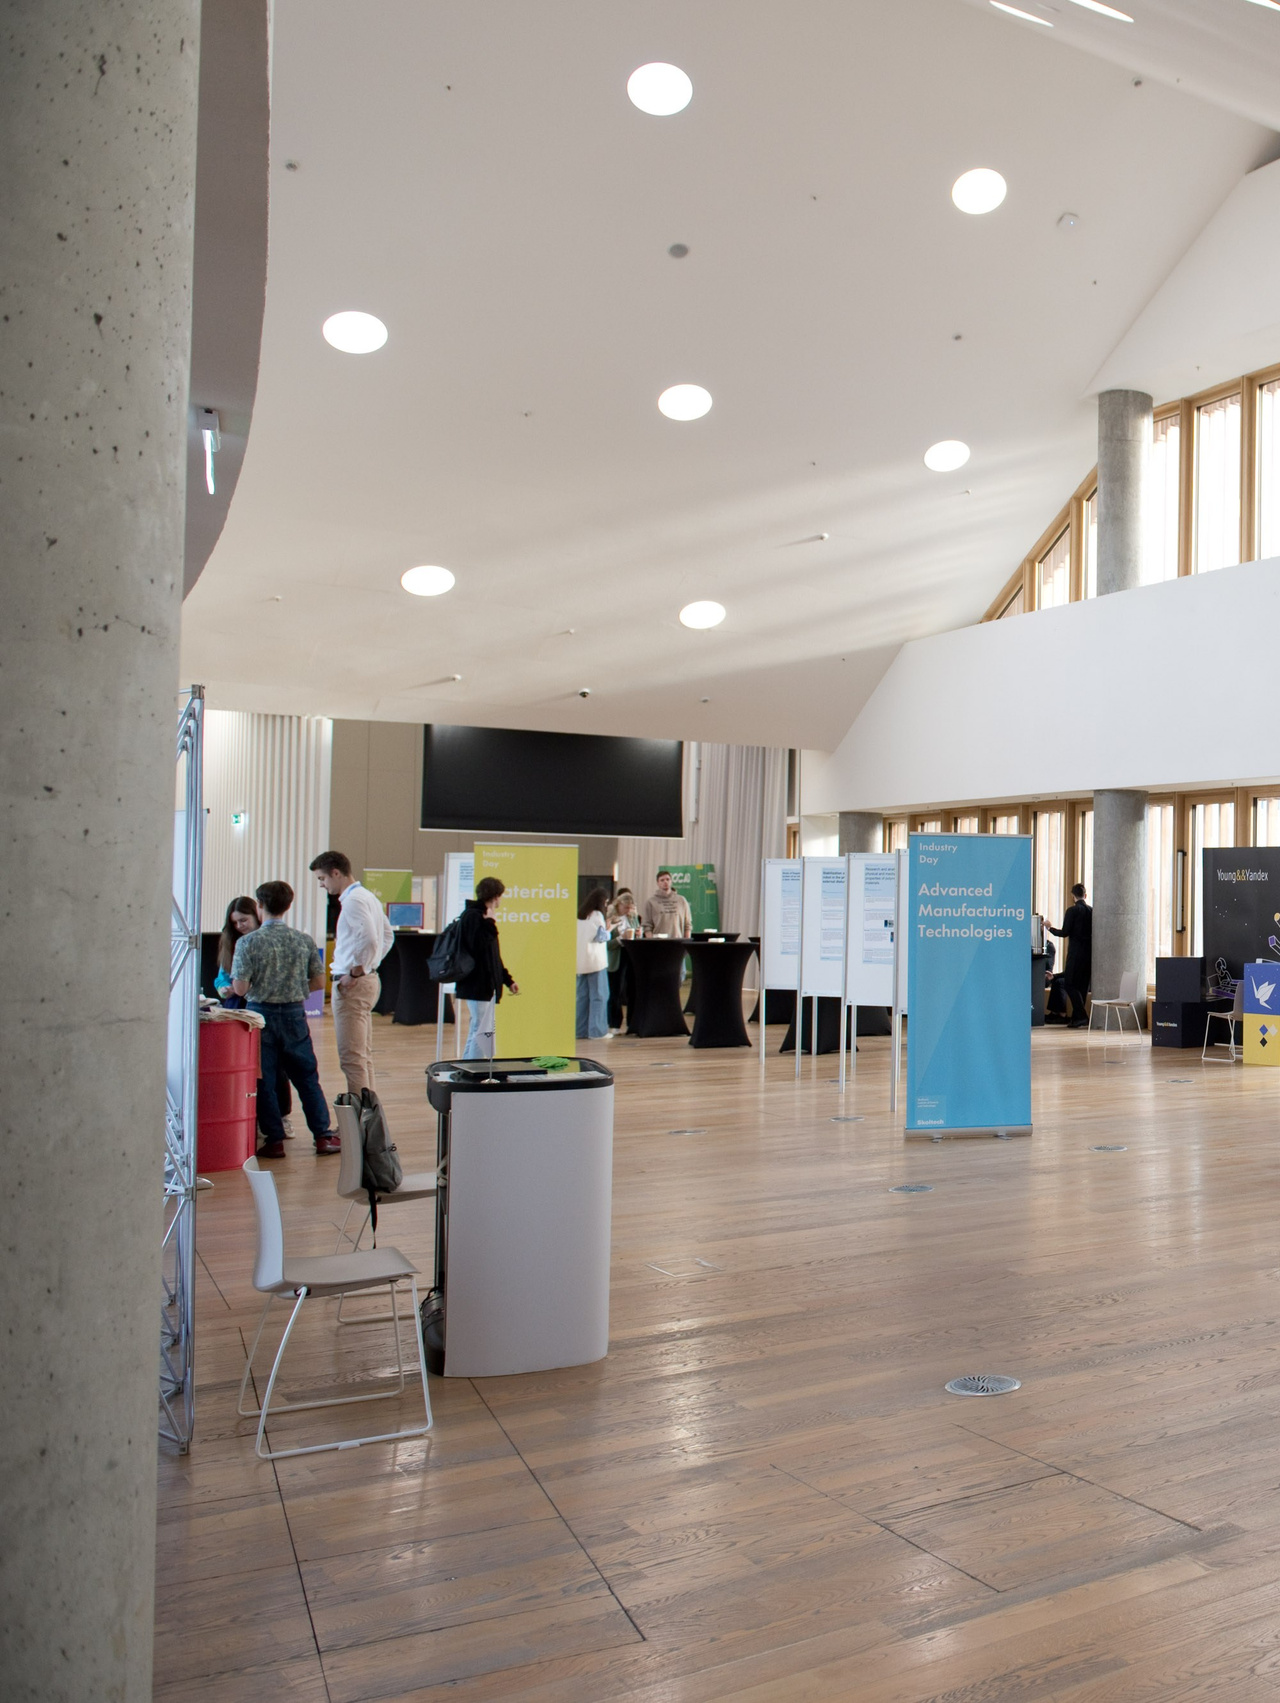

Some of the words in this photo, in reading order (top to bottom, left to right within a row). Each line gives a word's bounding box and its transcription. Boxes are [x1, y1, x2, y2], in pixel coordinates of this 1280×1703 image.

[482, 850, 516, 859] Industry
[919, 842, 958, 854] Industry
[482, 860, 500, 868] Day
[919, 855, 938, 866] Day
[1217, 869, 1268, 883] Young&&Yandex
[502, 883, 569, 899] aterials
[918, 882, 992, 896] Advanced
[495, 908, 550, 922] cience
[918, 903, 1025, 921] Manufacturing
[918, 924, 1013, 941] Technologies
